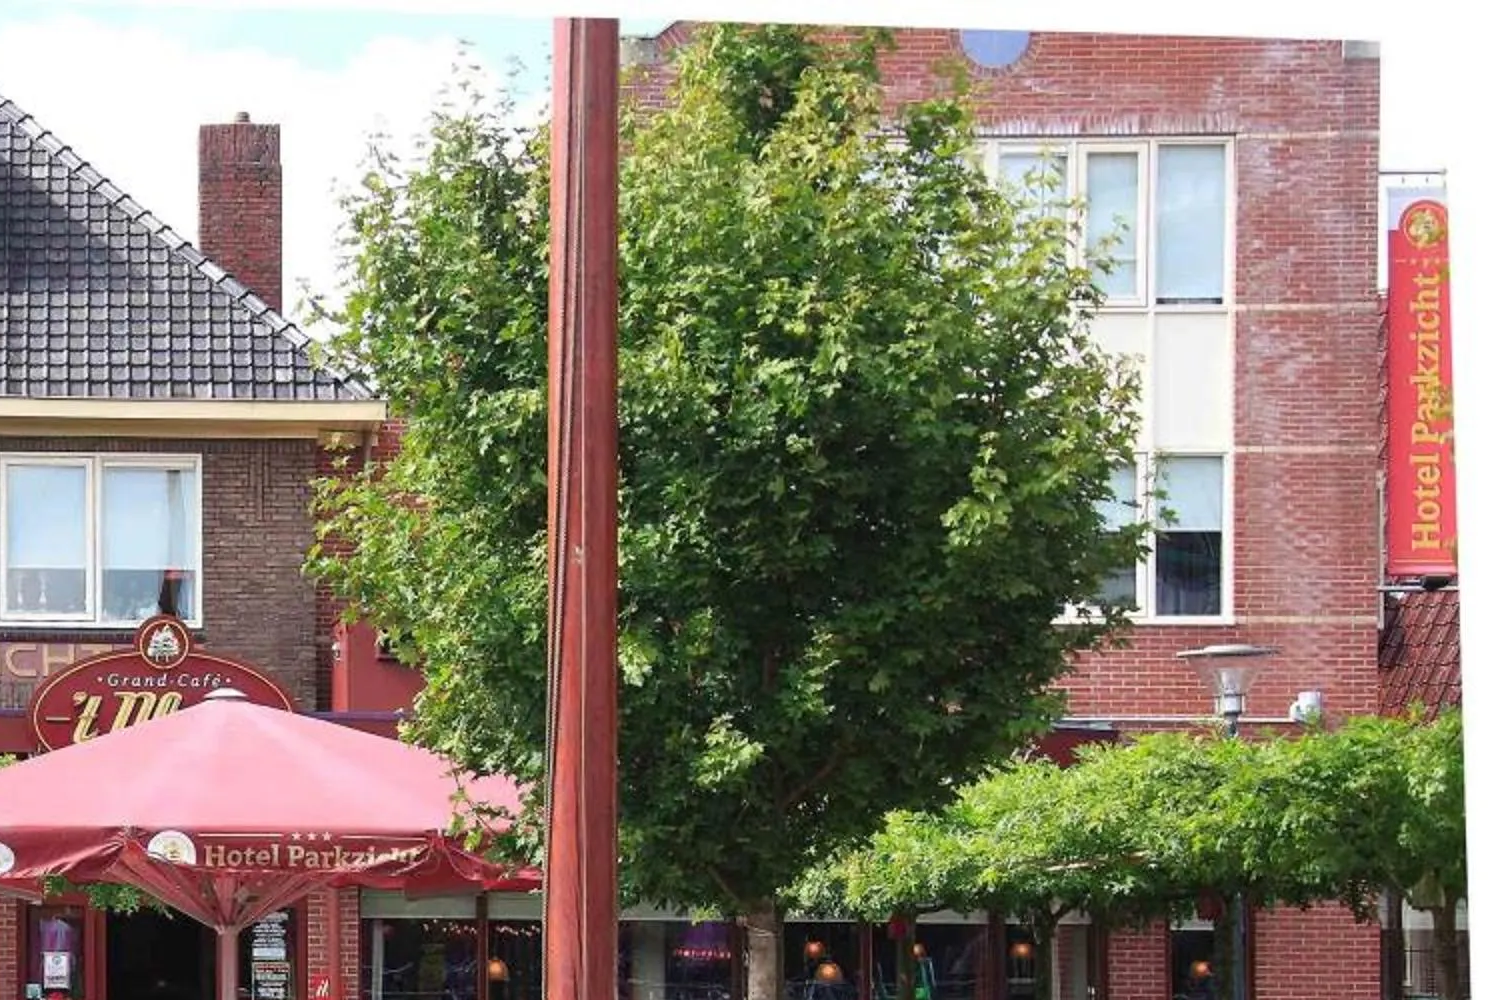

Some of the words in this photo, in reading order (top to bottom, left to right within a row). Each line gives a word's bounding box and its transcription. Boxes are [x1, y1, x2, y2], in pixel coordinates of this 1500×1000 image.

[1410, 272, 1442, 445] Parkzicht
[1410, 453, 1442, 551] Hotel
[204, 843, 280, 867] Hotel
